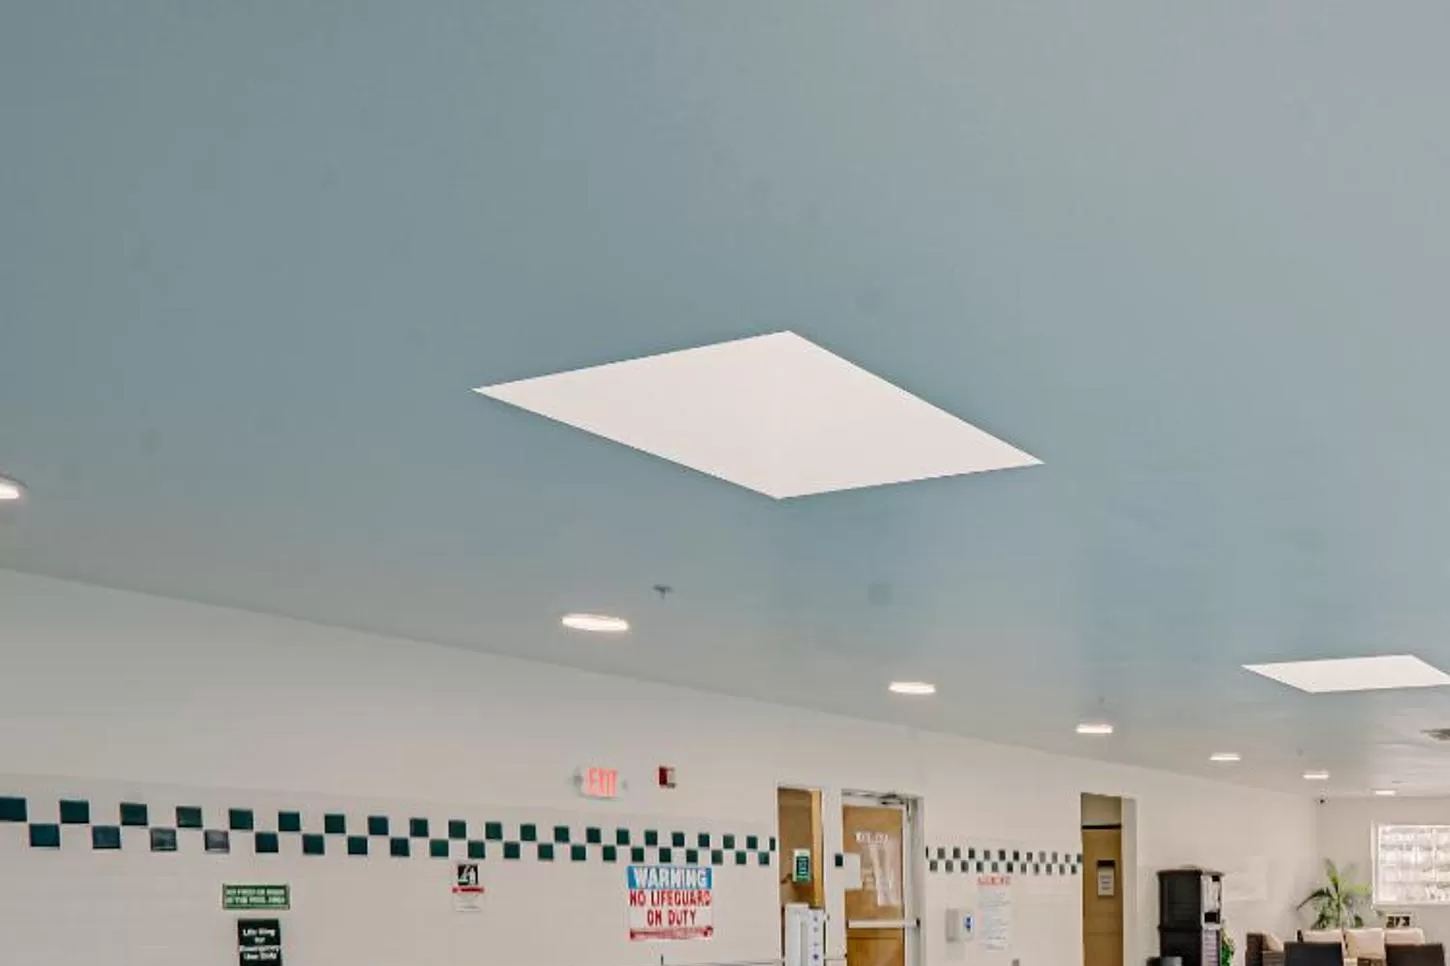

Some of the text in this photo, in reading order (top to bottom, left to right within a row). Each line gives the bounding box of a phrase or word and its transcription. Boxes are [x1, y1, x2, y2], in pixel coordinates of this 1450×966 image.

[633, 867, 707, 889] WARNING
[629, 888, 711, 907] NO LIFEGUARD
[647, 909, 697, 926] ON DUTY
